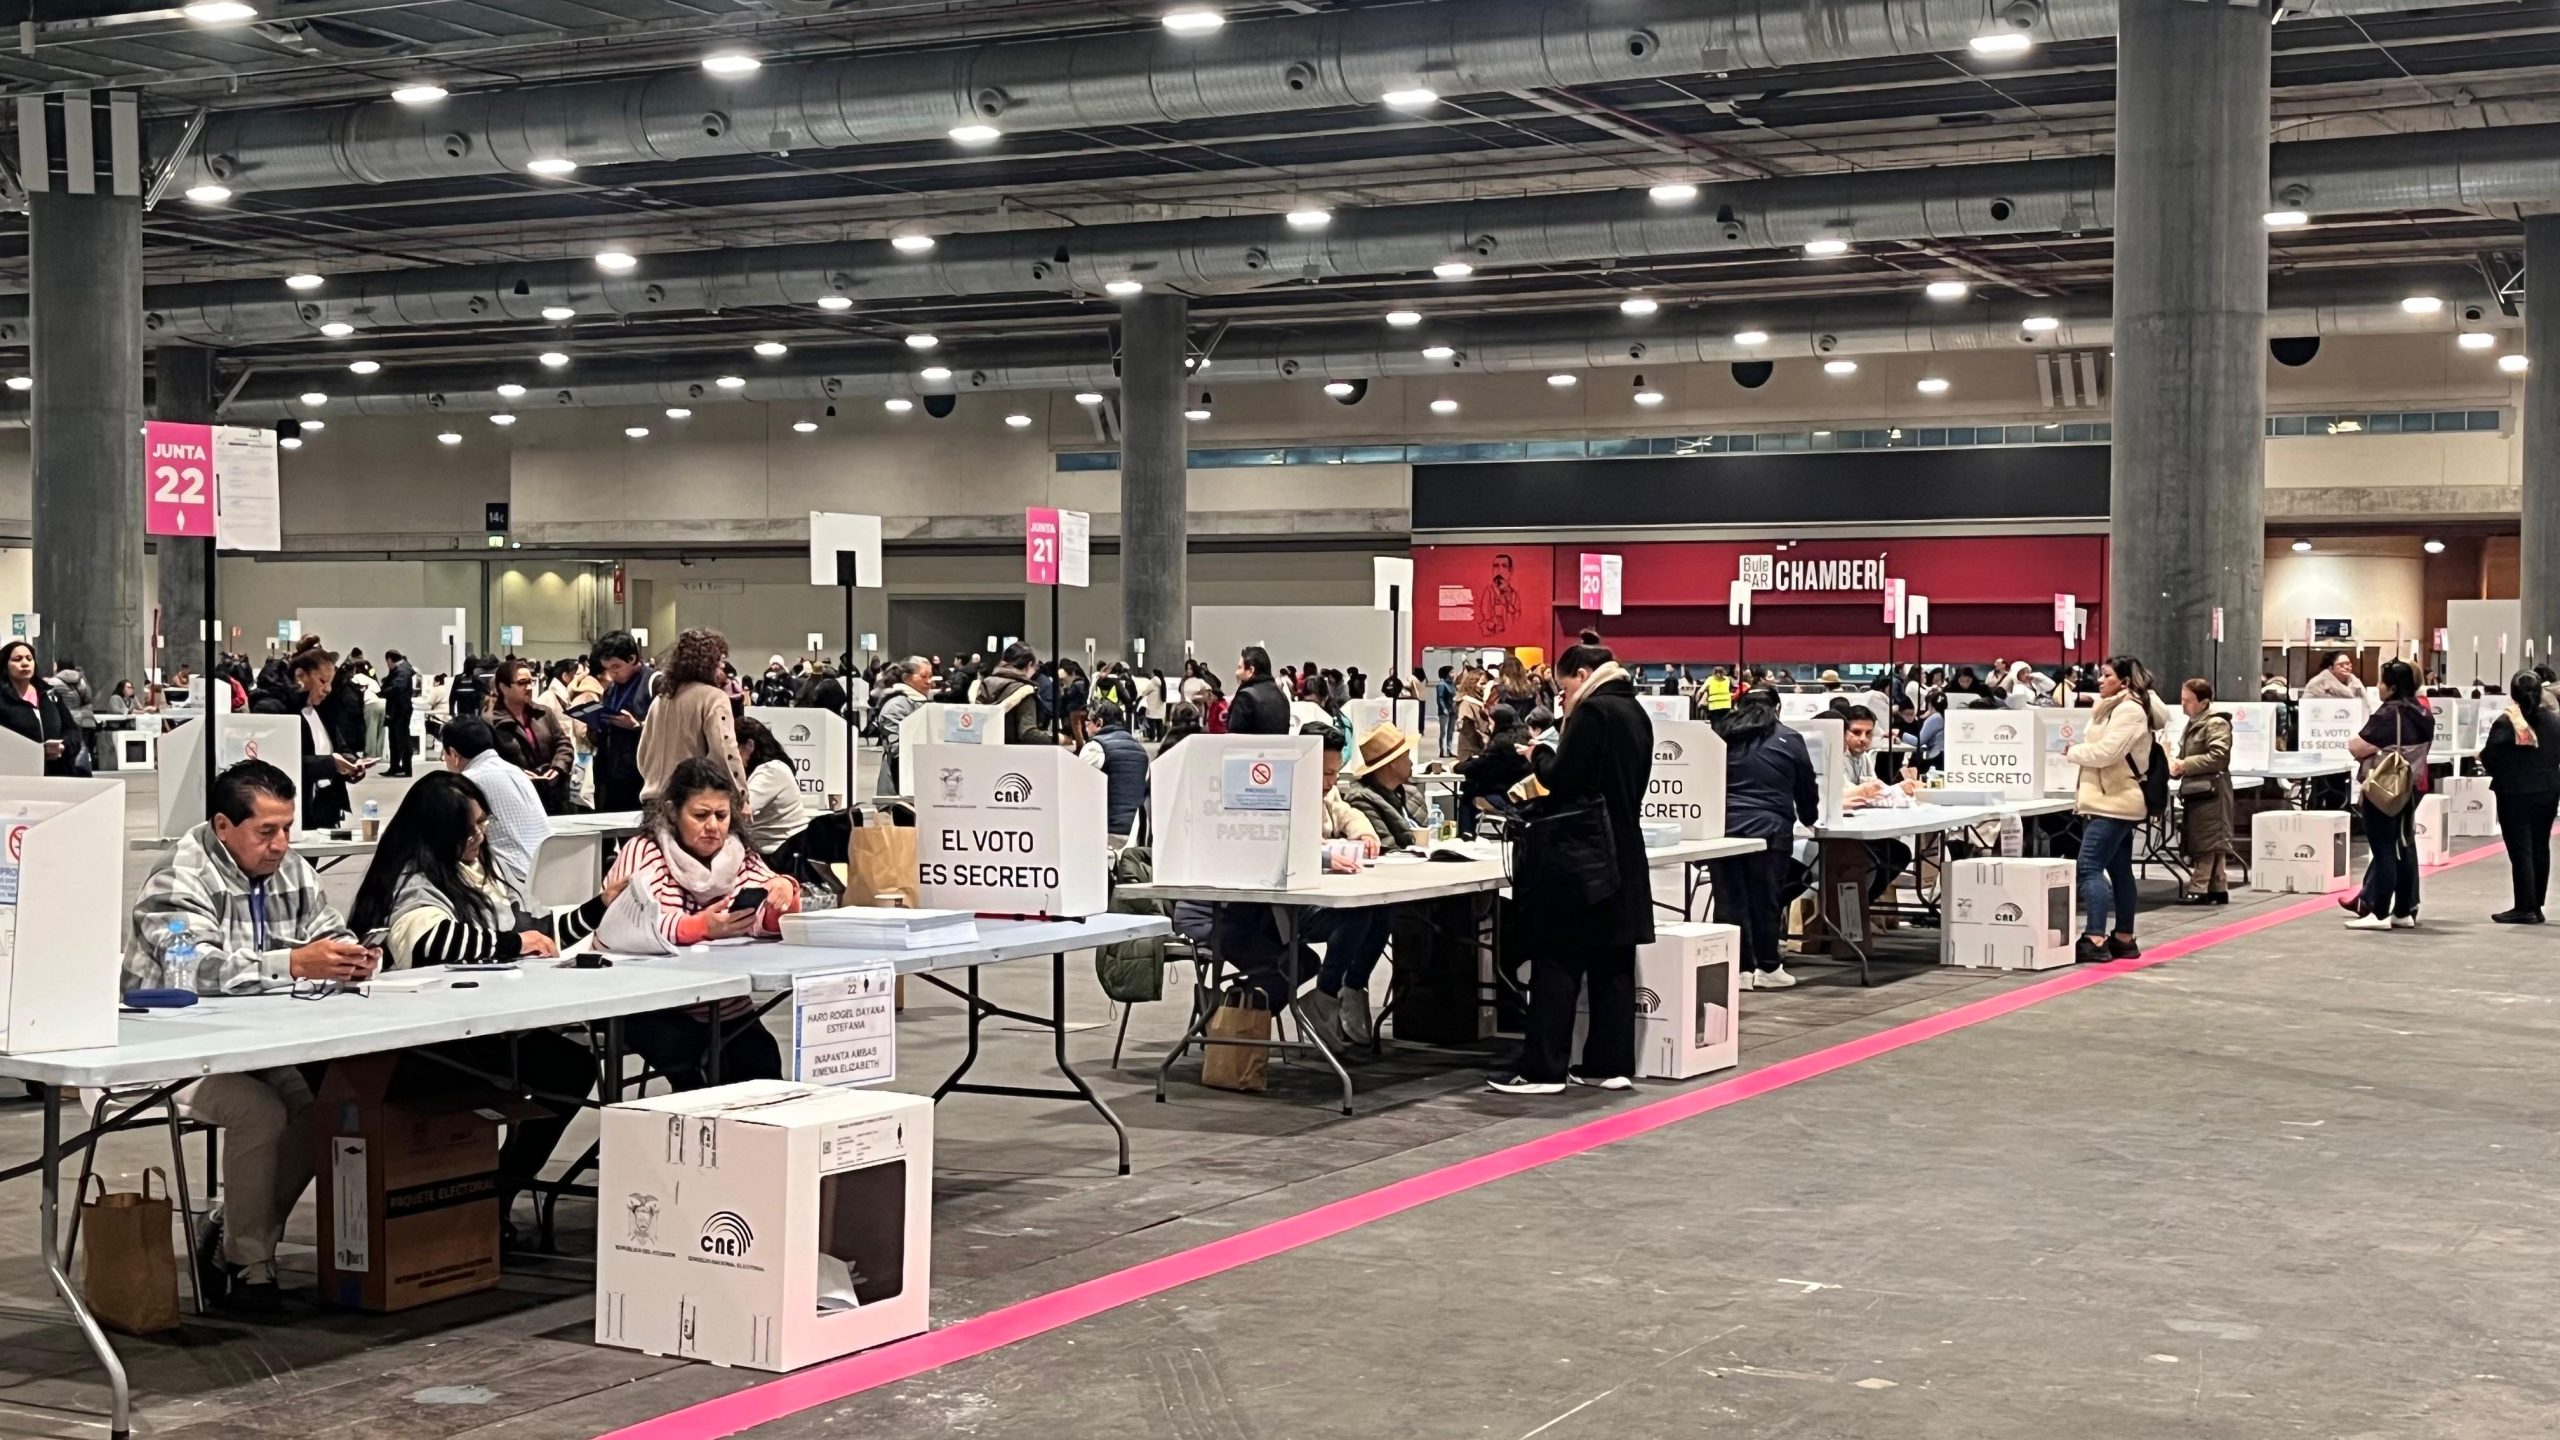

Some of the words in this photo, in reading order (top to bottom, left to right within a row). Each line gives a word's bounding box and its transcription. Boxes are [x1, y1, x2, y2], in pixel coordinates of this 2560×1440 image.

[152, 443, 206, 461] JUNTA
[154, 465, 205, 505] 22
[1032, 537, 1053, 563] 21
[1743, 556, 1769, 572] Bule
[1775, 552, 1887, 591] CHAMBERÍ
[1583, 575, 1600, 594] 20
[2311, 728, 2322, 738] EL
[2325, 729, 2351, 738] VOTO
[1961, 754, 1977, 766] EL
[1980, 754, 2017, 767] VOTO
[1947, 772, 1964, 784] ES
[1968, 772, 2032, 785] SECRETO
[994, 790, 1020, 803] CNE
[942, 829, 968, 852] EL
[972, 830, 1034, 854] VOTO
[919, 863, 947, 885] ES
[953, 864, 1059, 889] SECRETO
[847, 984, 857, 994] 22
[808, 1012, 828, 1024] HARO
[829, 1009, 854, 1021] ROGEL
[856, 1005, 886, 1018] DAYANA
[826, 1020, 866, 1034] ESTEFANIA
[851, 1046, 877, 1059] AMBAS
[839, 1059, 880, 1073] ELIZABETH
[700, 1235, 735, 1256] CNE
